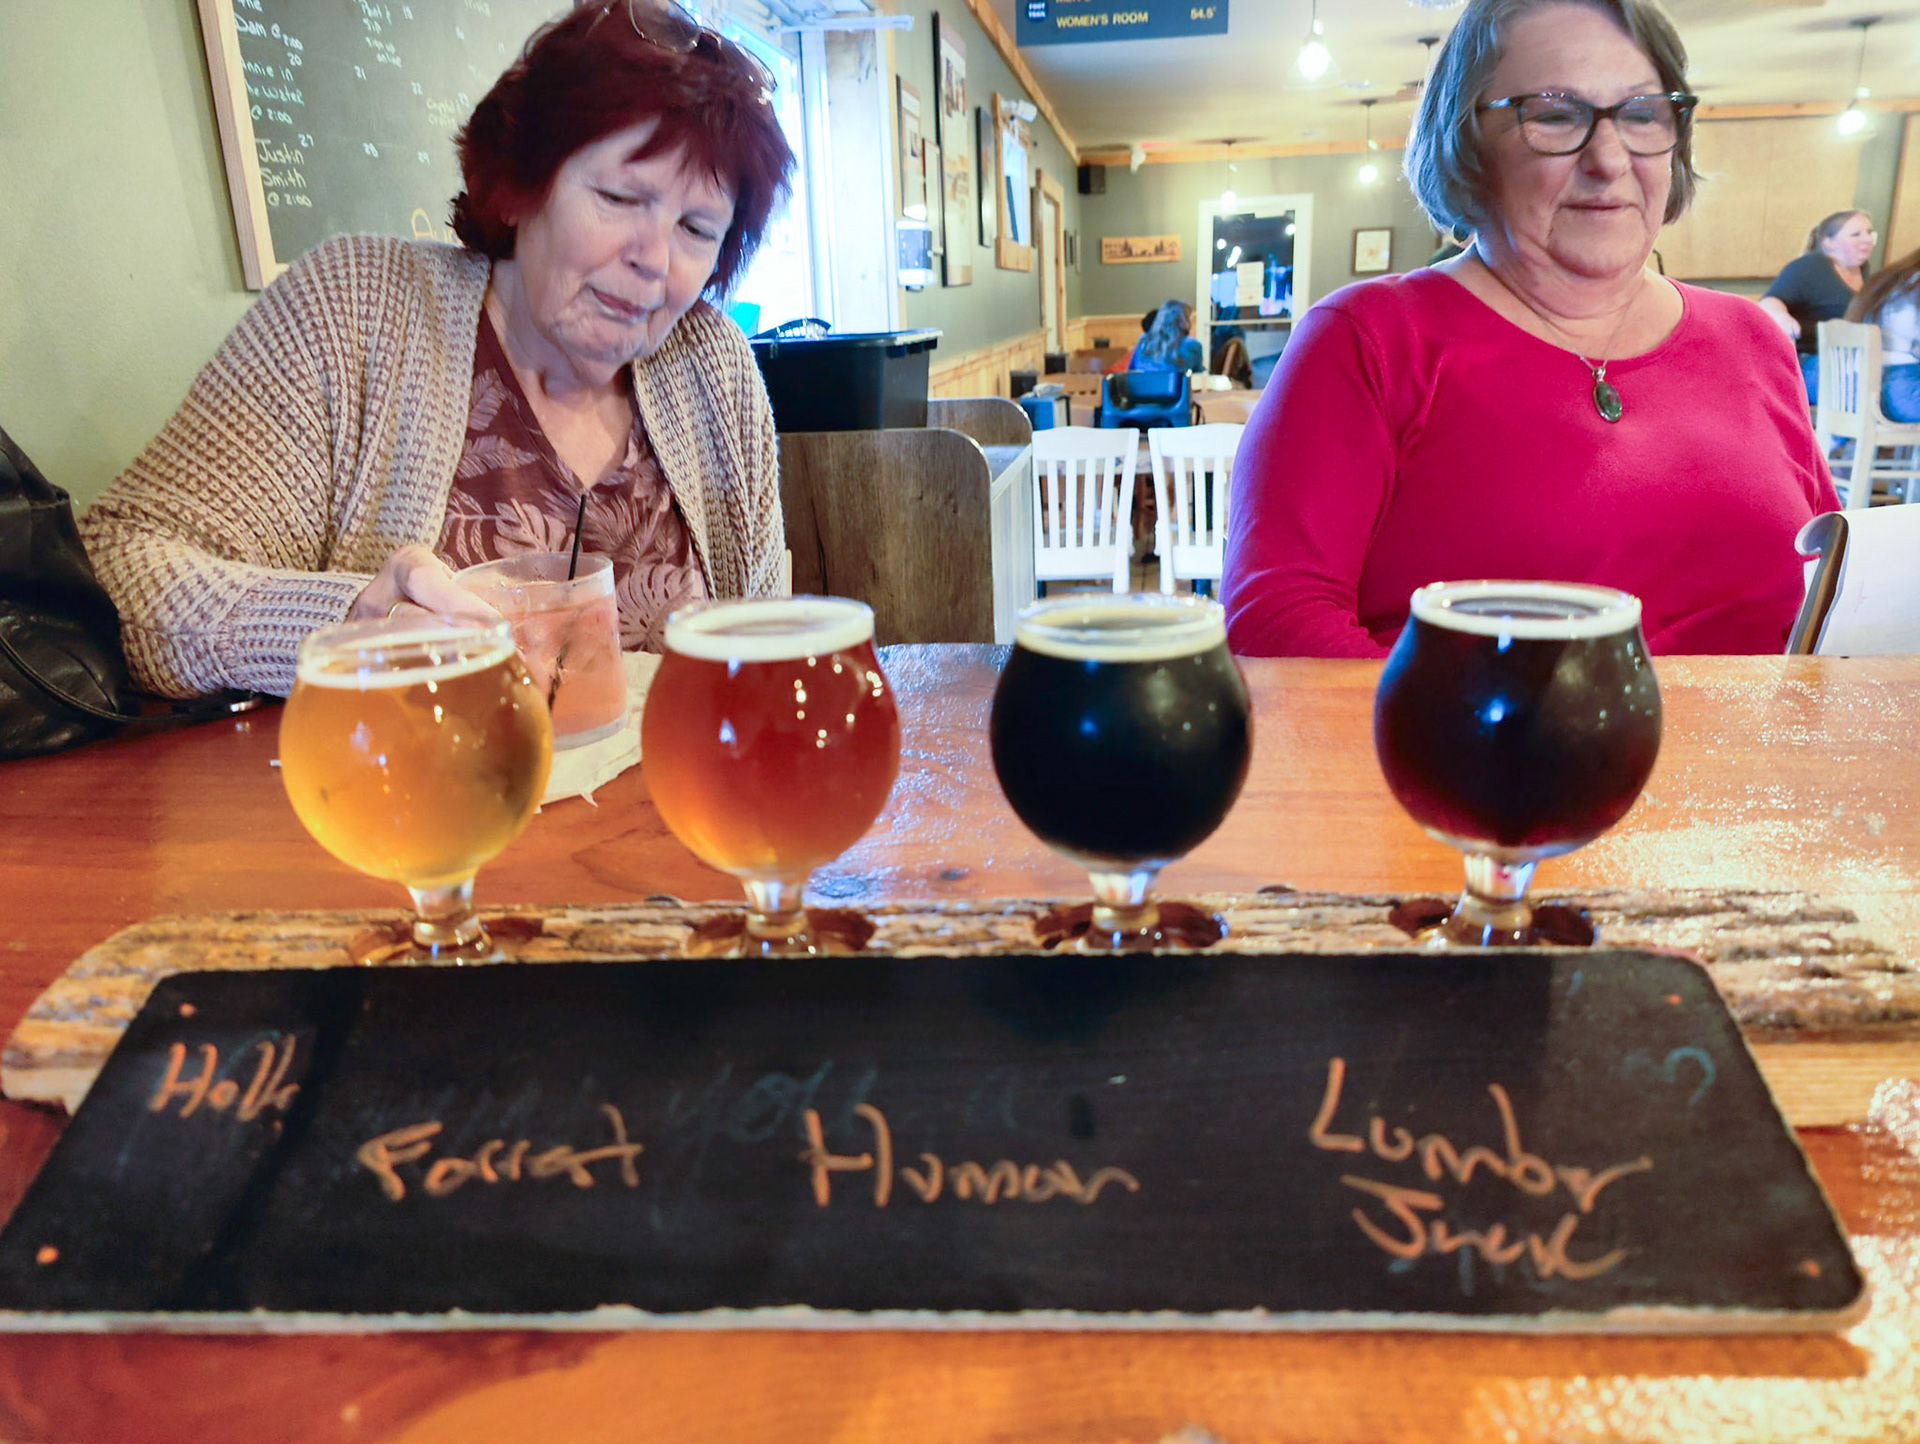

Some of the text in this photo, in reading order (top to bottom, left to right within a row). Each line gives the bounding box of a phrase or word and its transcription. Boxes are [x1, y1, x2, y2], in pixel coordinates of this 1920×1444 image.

[1056, 13, 1109, 29] WOMEN'S
[1113, 11, 1149, 25] ROOM
[256, 138, 305, 165] Justin
[260, 167, 307, 188] Smith
[801, 1102, 1140, 1208] Human
